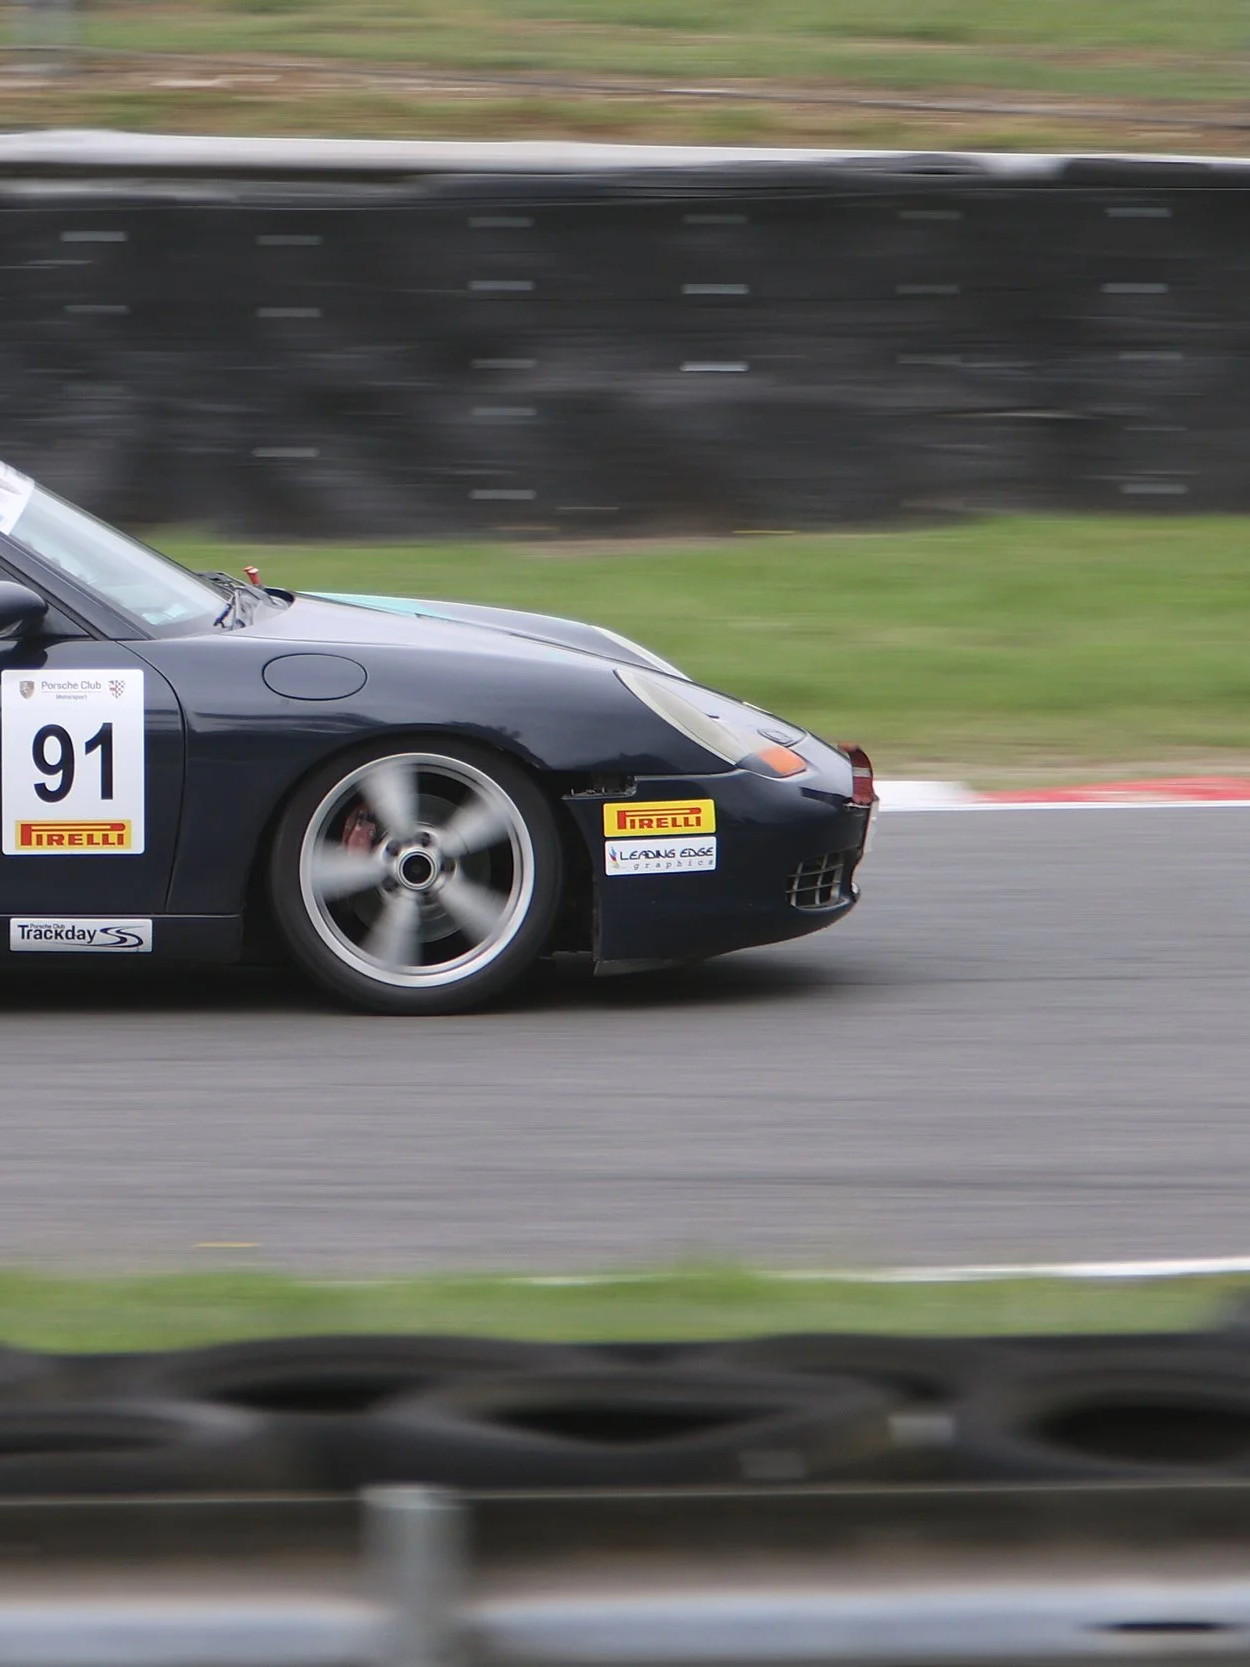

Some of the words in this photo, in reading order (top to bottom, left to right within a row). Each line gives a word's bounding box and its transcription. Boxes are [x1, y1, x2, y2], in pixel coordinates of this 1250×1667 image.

[41, 680, 79, 690] Porsche
[80, 680, 102, 690] Club
[31, 721, 114, 803] 91
[616, 807, 702, 830] PIRELLI
[20, 822, 126, 846] PIRELLI
[619, 848, 676, 861] LEADING
[679, 846, 714, 858] EDGE
[17, 924, 97, 944] Trackday
